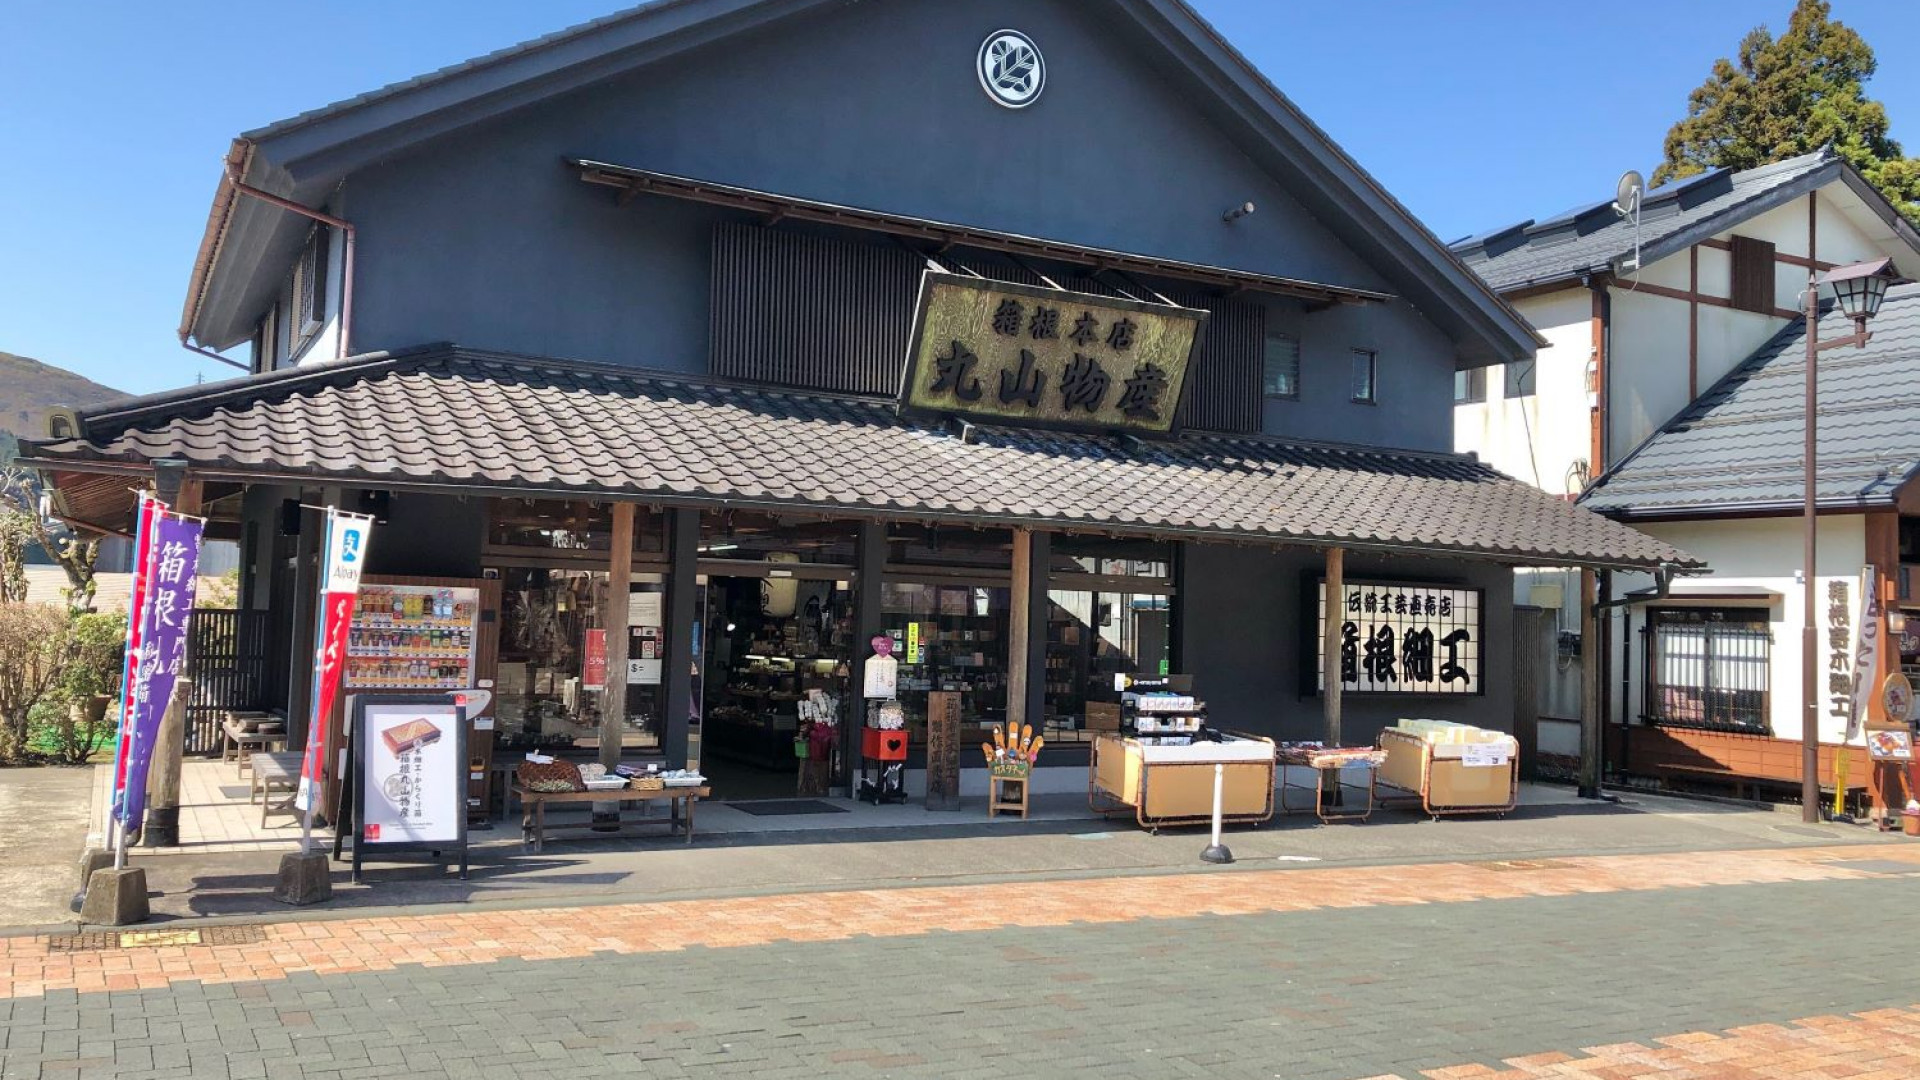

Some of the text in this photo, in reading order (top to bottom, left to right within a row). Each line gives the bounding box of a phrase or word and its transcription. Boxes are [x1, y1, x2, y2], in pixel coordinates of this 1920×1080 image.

[992, 300, 1138, 350] 箱根本店
[930, 338, 1168, 421] 丸山物産
[1828, 580, 1850, 718] 箱根寄木細工
